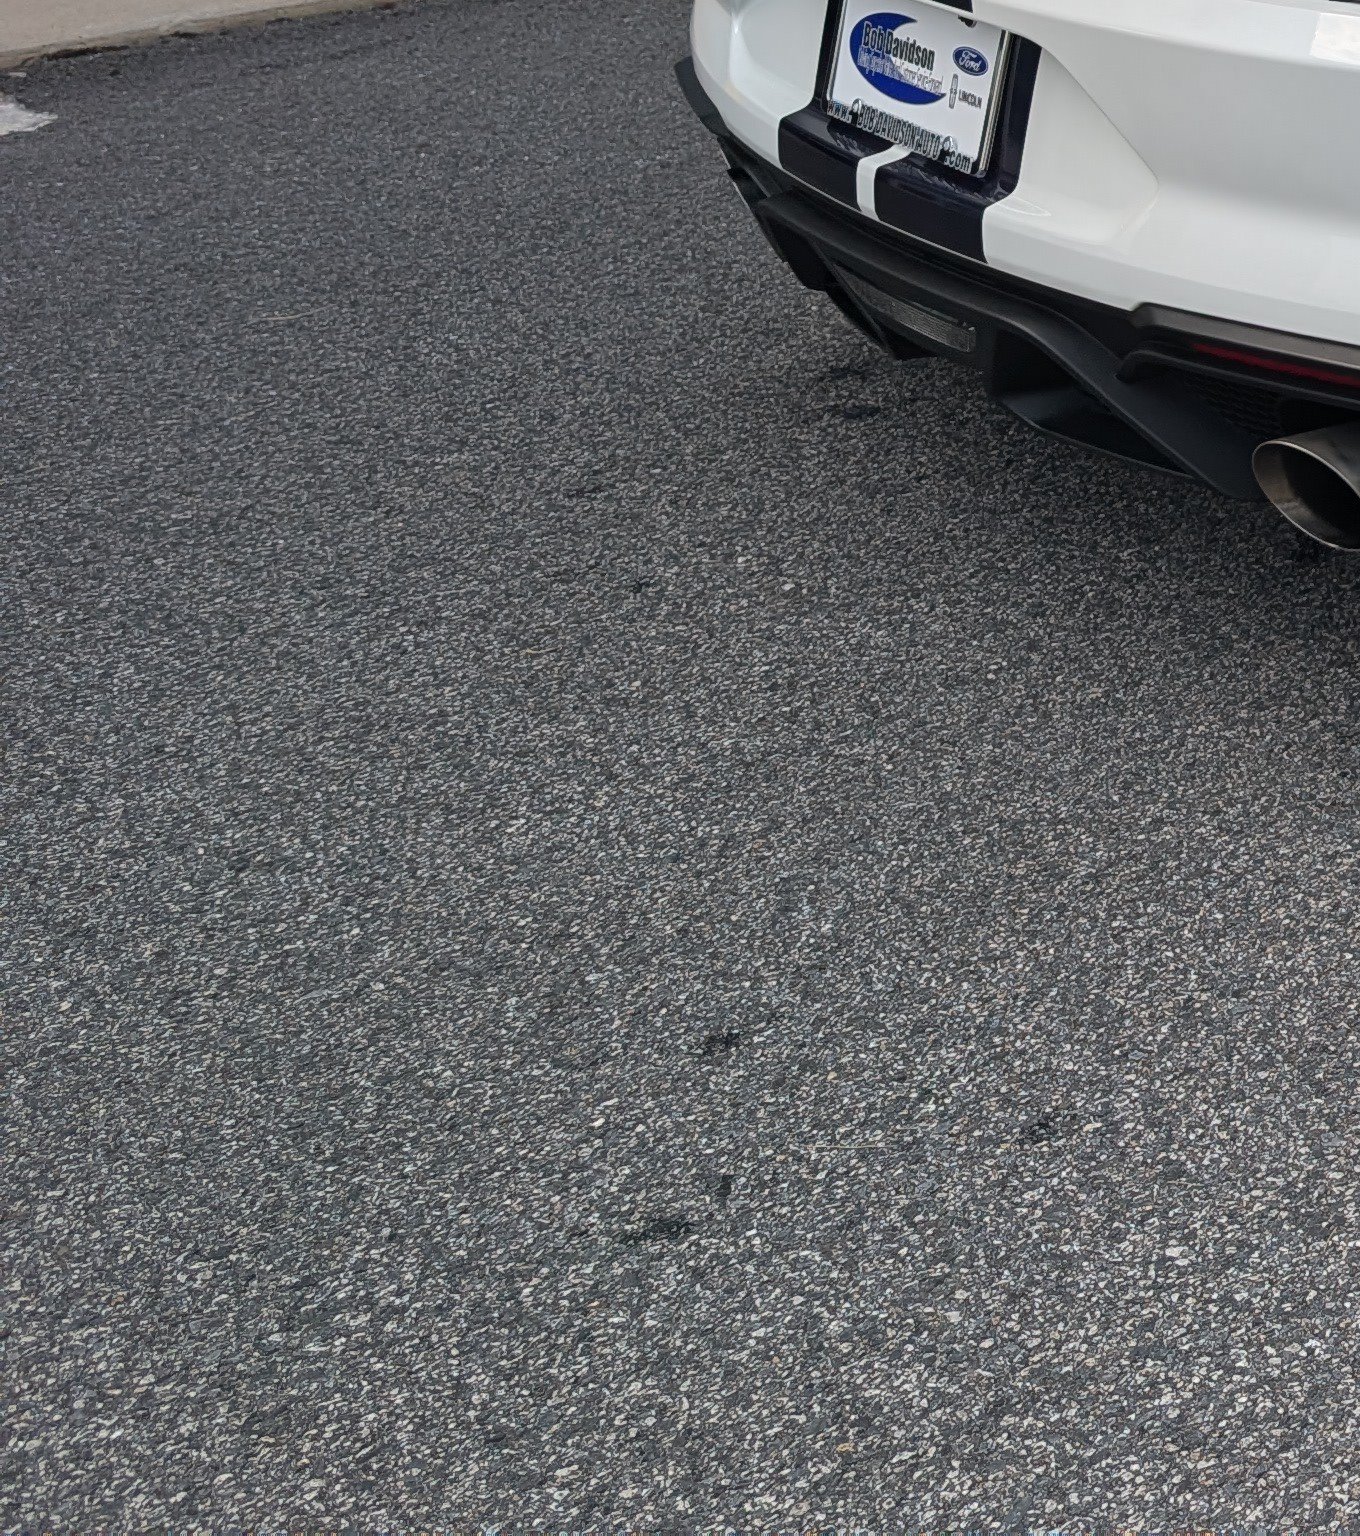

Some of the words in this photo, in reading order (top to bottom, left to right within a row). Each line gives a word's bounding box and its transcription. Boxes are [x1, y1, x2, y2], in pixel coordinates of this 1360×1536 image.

[862, 21, 885, 54] Bob
[885, 29, 935, 72] Davidson
[957, 49, 983, 73] Ford
[958, 89, 982, 109] LINCOLN
